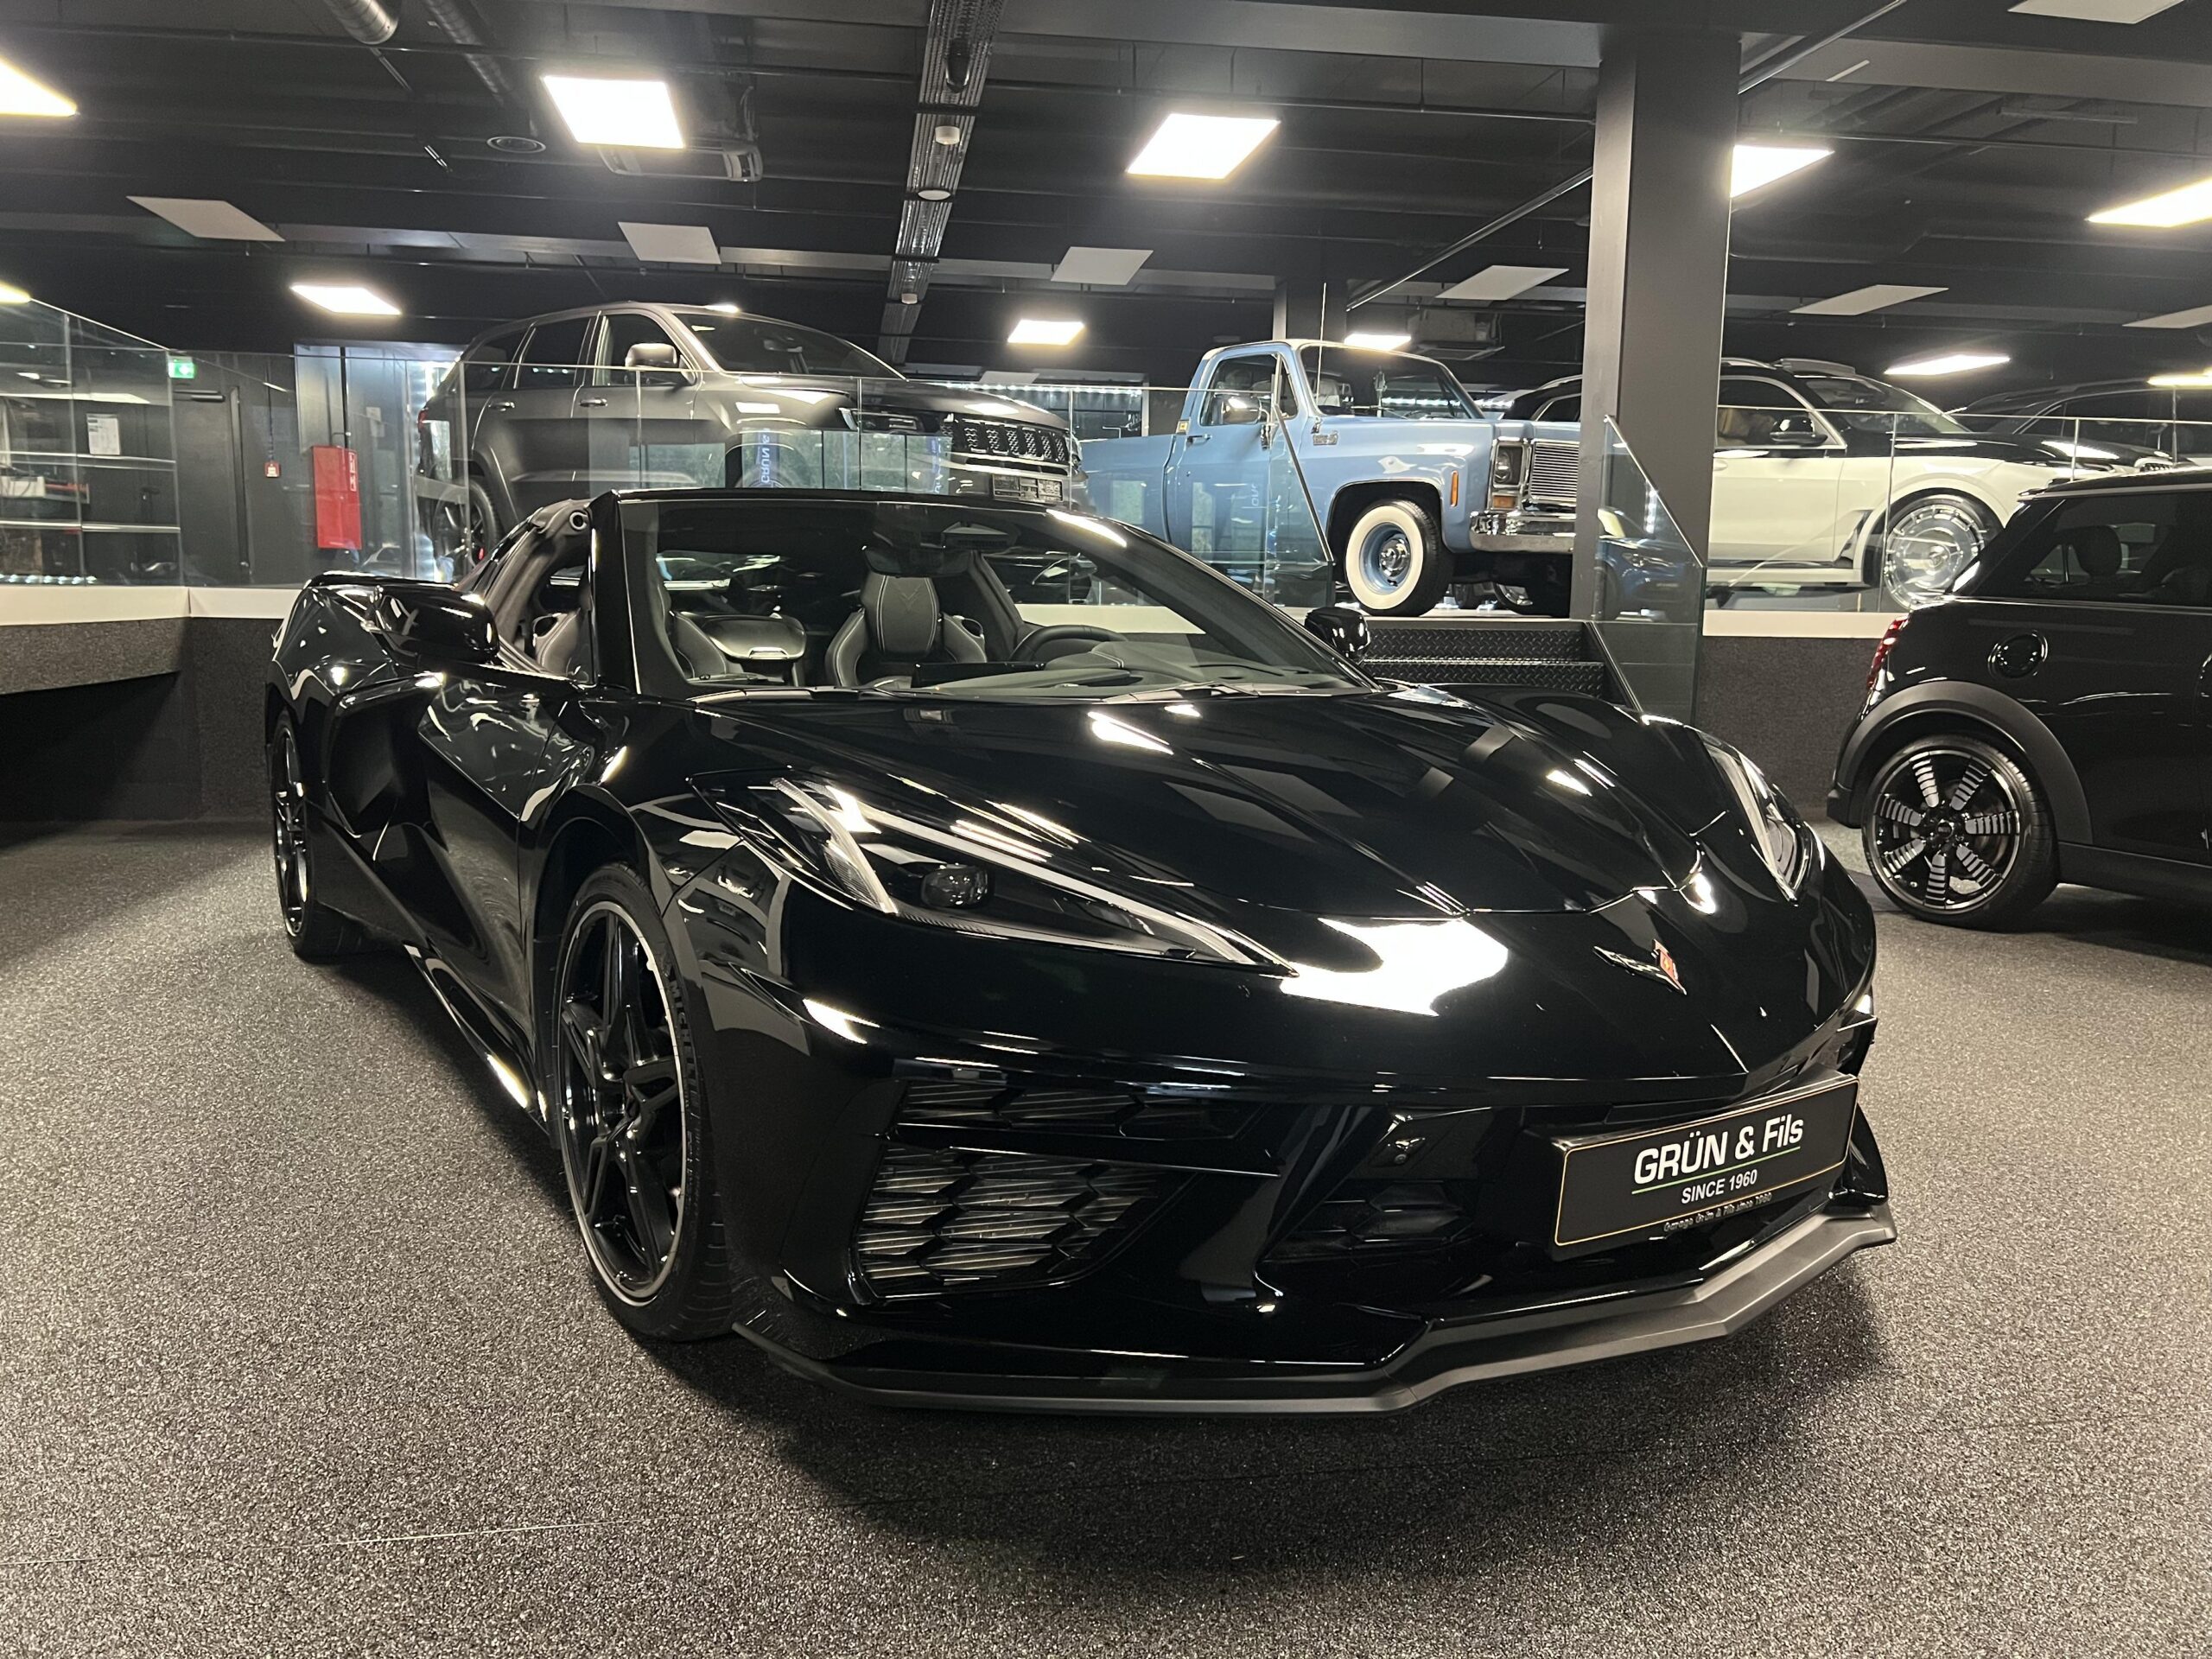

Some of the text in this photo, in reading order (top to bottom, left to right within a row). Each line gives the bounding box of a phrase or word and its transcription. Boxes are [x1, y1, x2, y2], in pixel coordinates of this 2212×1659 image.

[1634, 1114, 1804, 1185] GRÜN & Fils
[1681, 1169, 1758, 1205] SINCE 1960
[1663, 1217, 1694, 1232] Garage
[1715, 1207, 1722, 1217] &
